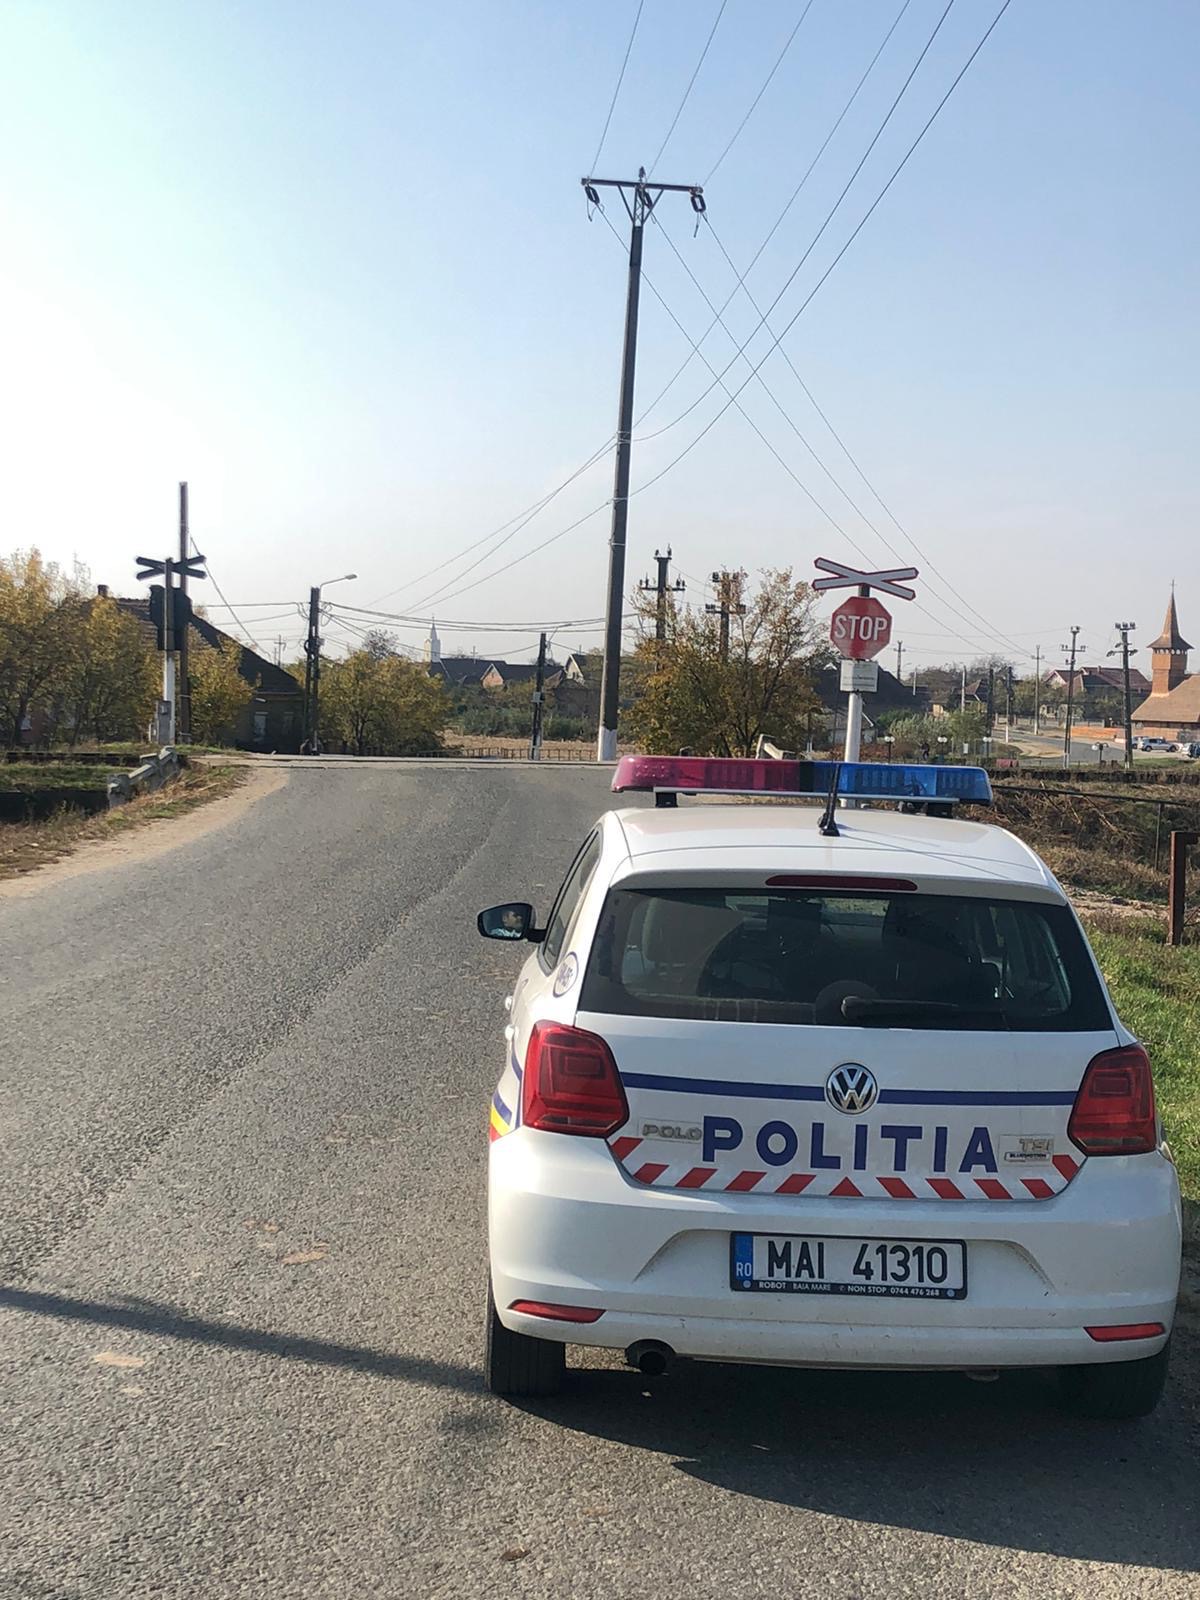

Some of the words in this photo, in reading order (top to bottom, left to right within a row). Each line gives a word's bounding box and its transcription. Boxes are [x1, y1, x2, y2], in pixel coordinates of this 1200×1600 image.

[834, 614, 888, 641] STOP
[829, 1065, 875, 1112] VW
[642, 1124, 702, 1141] POLO
[702, 1115, 998, 1174] POLITIA
[1019, 1138, 1050, 1152] TSI
[736, 1262, 752, 1277] RO
[767, 1240, 825, 1280] MAI
[852, 1242, 948, 1284] 41310
[758, 1281, 787, 1290] ROBOT
[847, 1285, 866, 1293] NON
[867, 1286, 887, 1294] STOP
